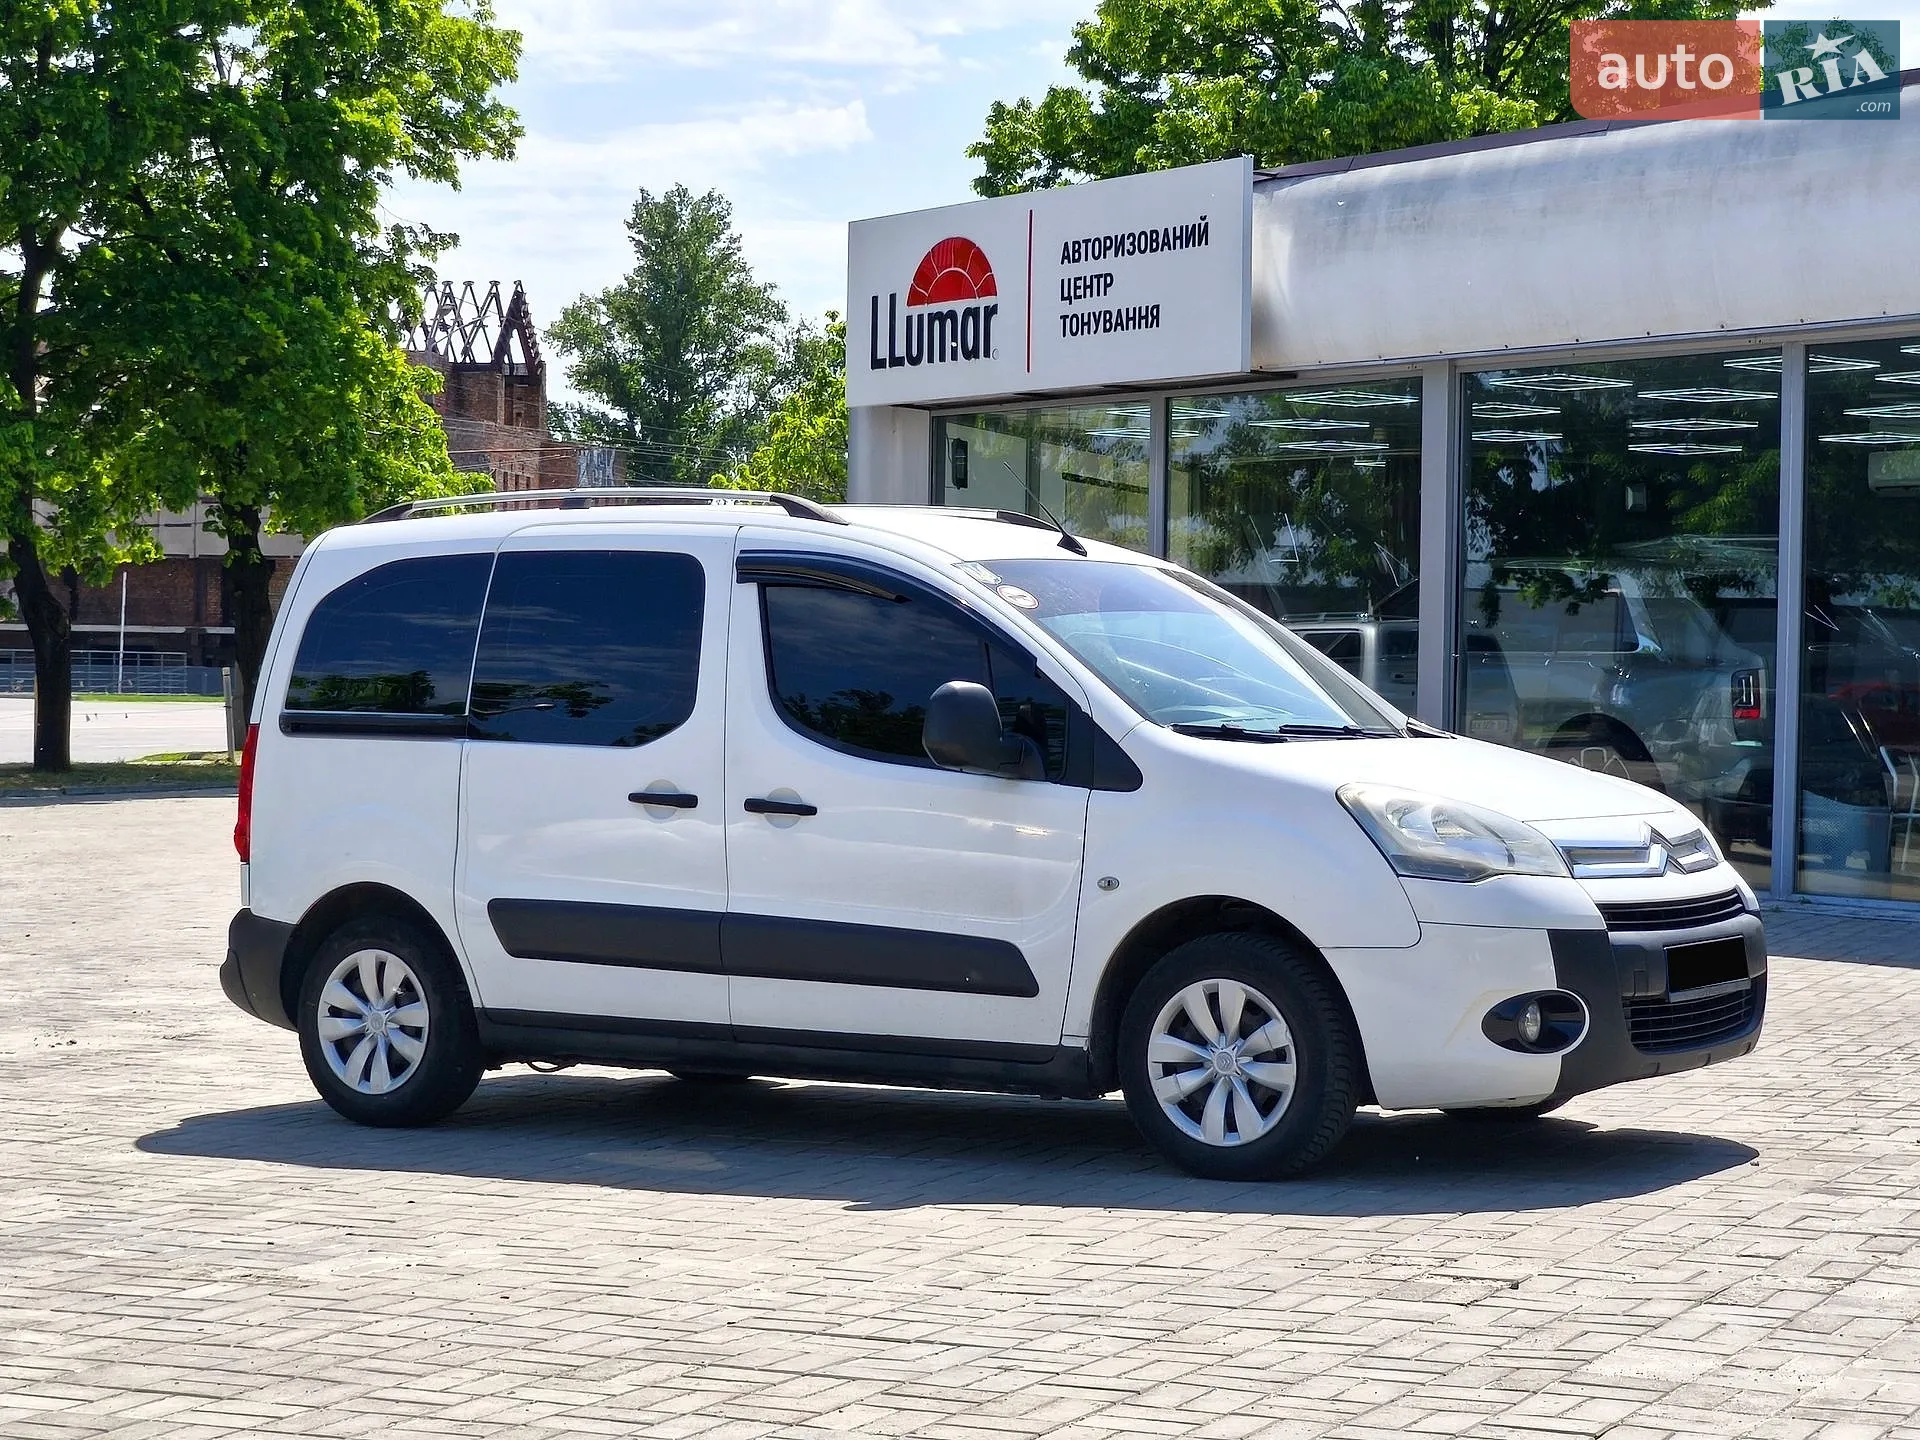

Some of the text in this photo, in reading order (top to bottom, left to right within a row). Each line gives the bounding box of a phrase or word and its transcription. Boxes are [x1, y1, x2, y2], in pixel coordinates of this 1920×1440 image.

[1060, 215, 1209, 265] АВТОРИЗОВАНИЙ
[1060, 273, 1114, 305] ЦЕНТР
[870, 291, 998, 370] LLumar
[1060, 303, 1160, 338] ТОНУВАННЯ
